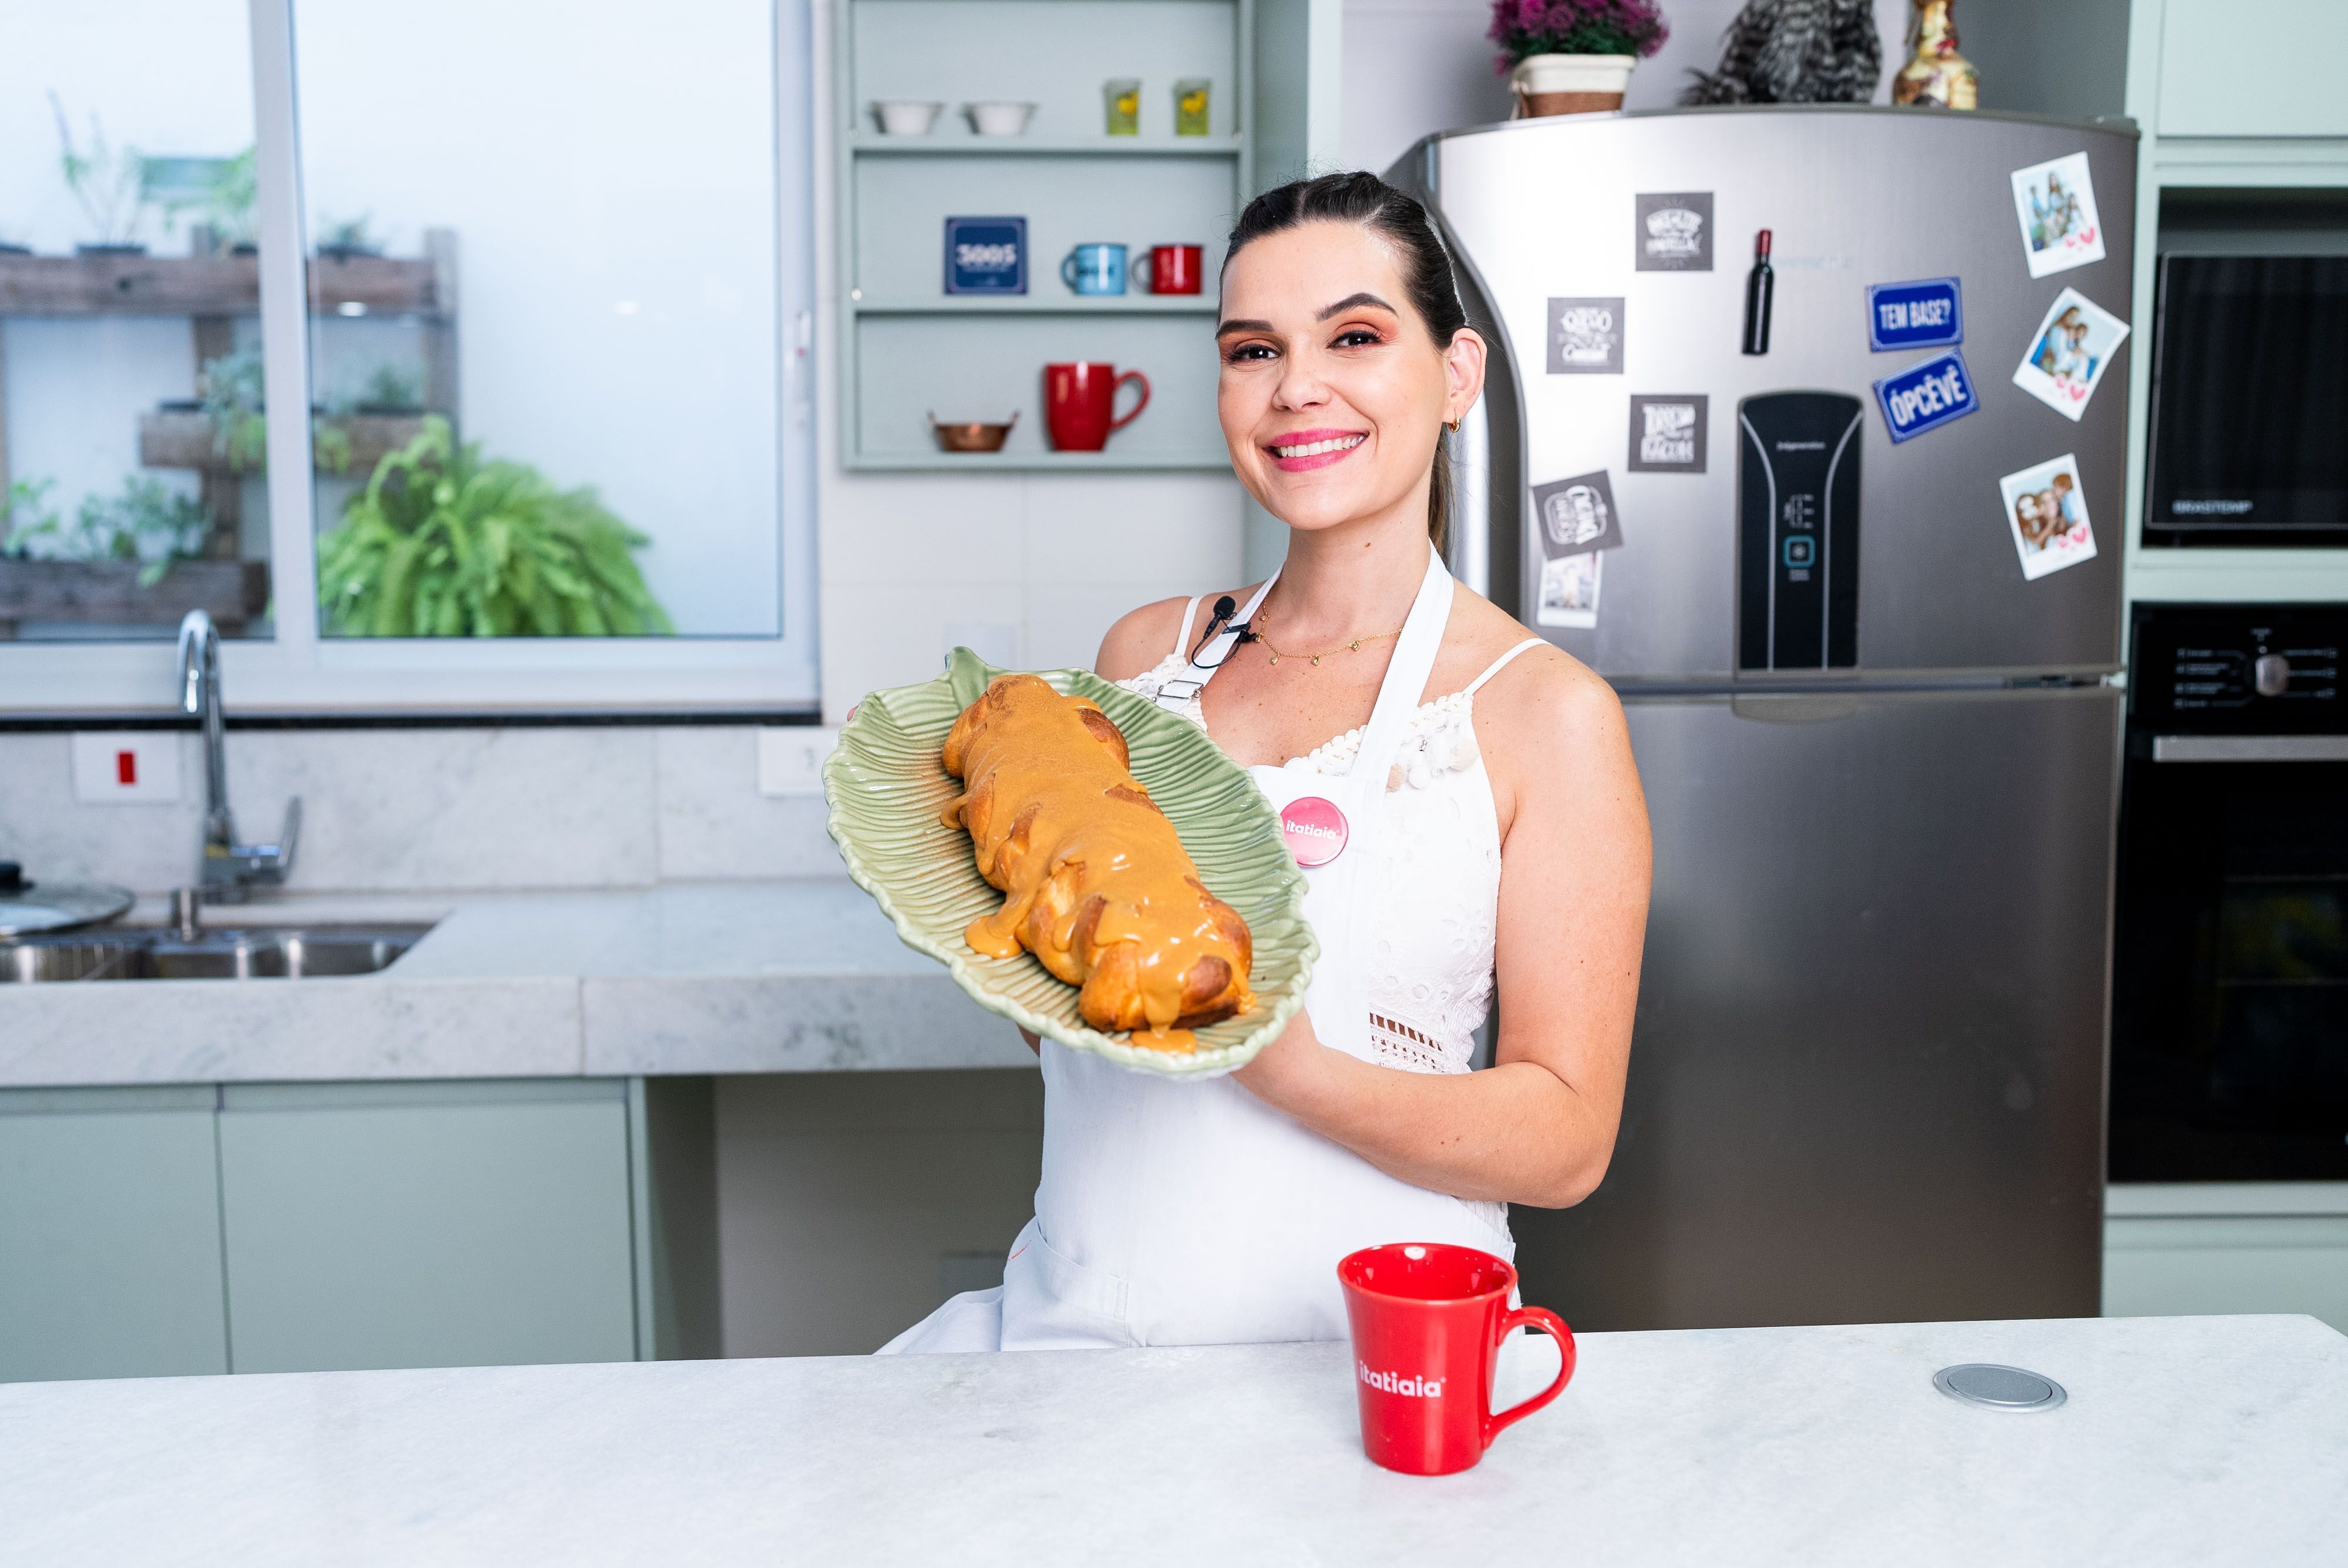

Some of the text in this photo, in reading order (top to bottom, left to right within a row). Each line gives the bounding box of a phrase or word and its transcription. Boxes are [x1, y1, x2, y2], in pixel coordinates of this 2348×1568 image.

[1879, 299, 1952, 331] TEM BASE?
[1286, 820, 1337, 839] itatiaia
[1359, 1359, 1442, 1398] itatiaia
